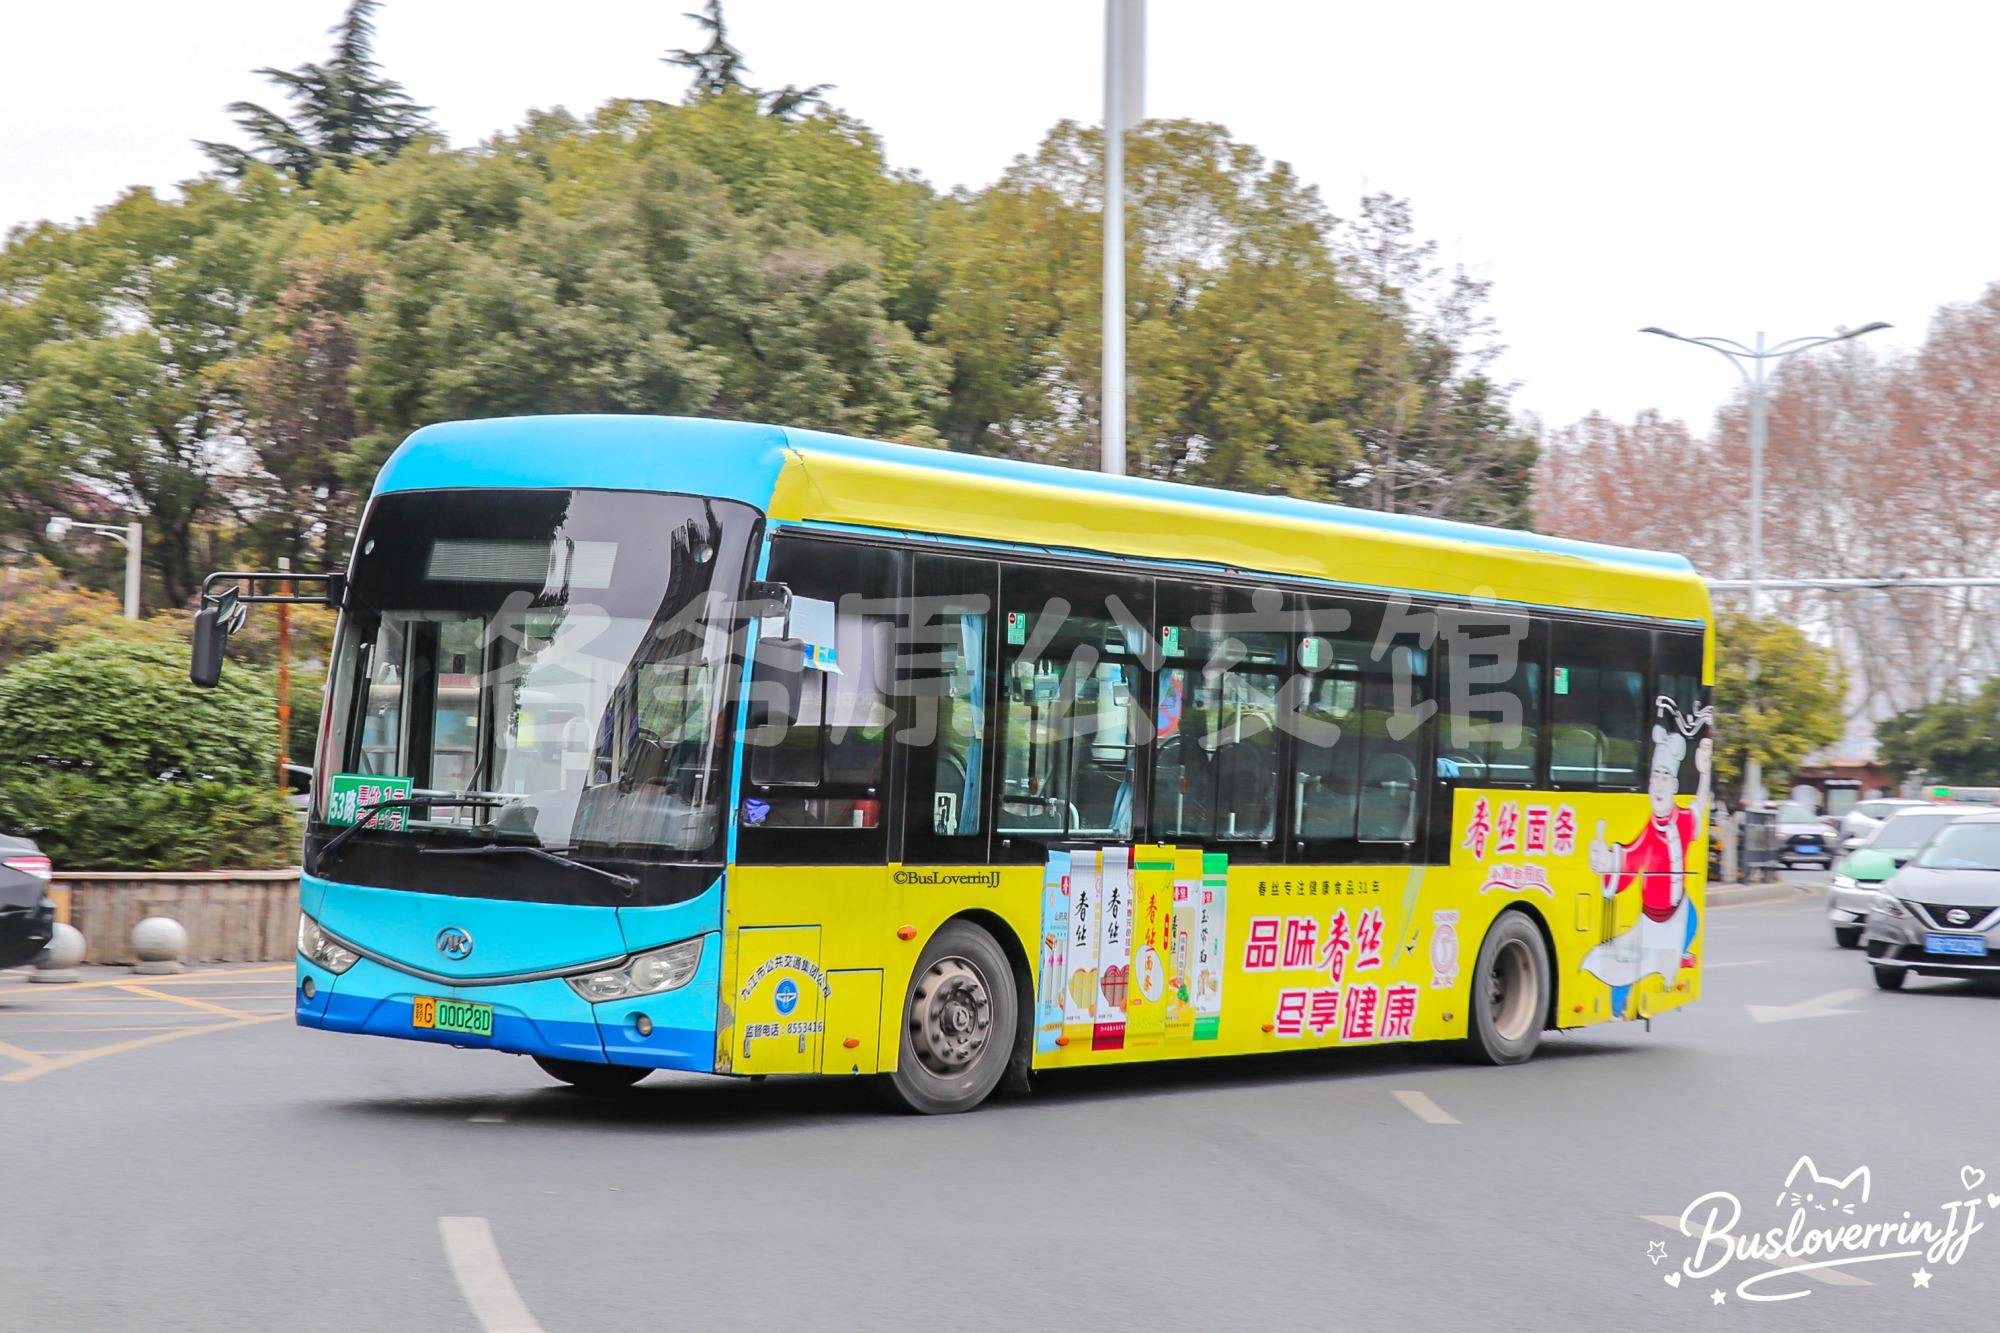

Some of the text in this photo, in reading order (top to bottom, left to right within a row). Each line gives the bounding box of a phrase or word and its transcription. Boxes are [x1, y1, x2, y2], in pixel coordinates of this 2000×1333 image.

[331, 789, 357, 824] 53路
[1462, 798, 1575, 860] 春丝面条
[1244, 908, 1384, 983] 品味春丝
[740, 954, 832, 1001] 九江市公共交通集团公司
[1276, 985, 1418, 1040] 尽享健康
